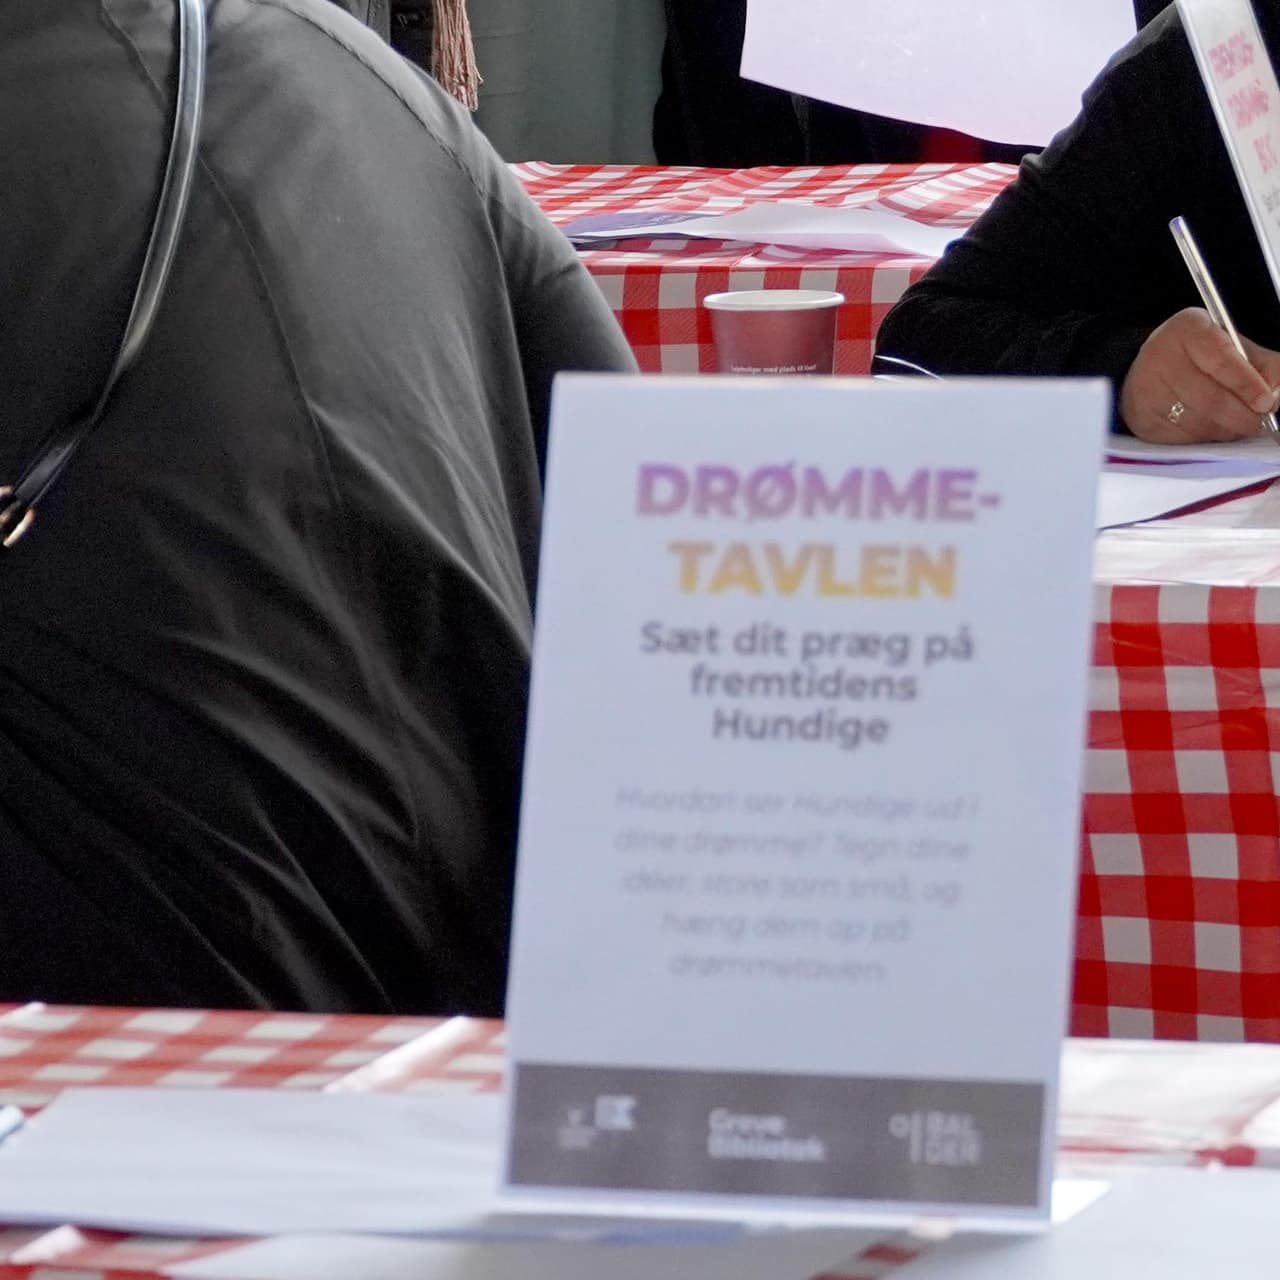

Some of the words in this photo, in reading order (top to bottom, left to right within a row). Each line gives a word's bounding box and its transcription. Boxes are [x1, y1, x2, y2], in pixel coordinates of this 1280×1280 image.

[635, 461, 1002, 523] DRØMME-
[667, 539, 958, 599] TAVLEN
[640, 620, 719, 654] Sæt
[732, 622, 788, 657] dit
[800, 628, 911, 667] præg
[924, 624, 975, 666] på
[690, 663, 918, 702] fremtidens
[712, 707, 890, 751] Hundige
